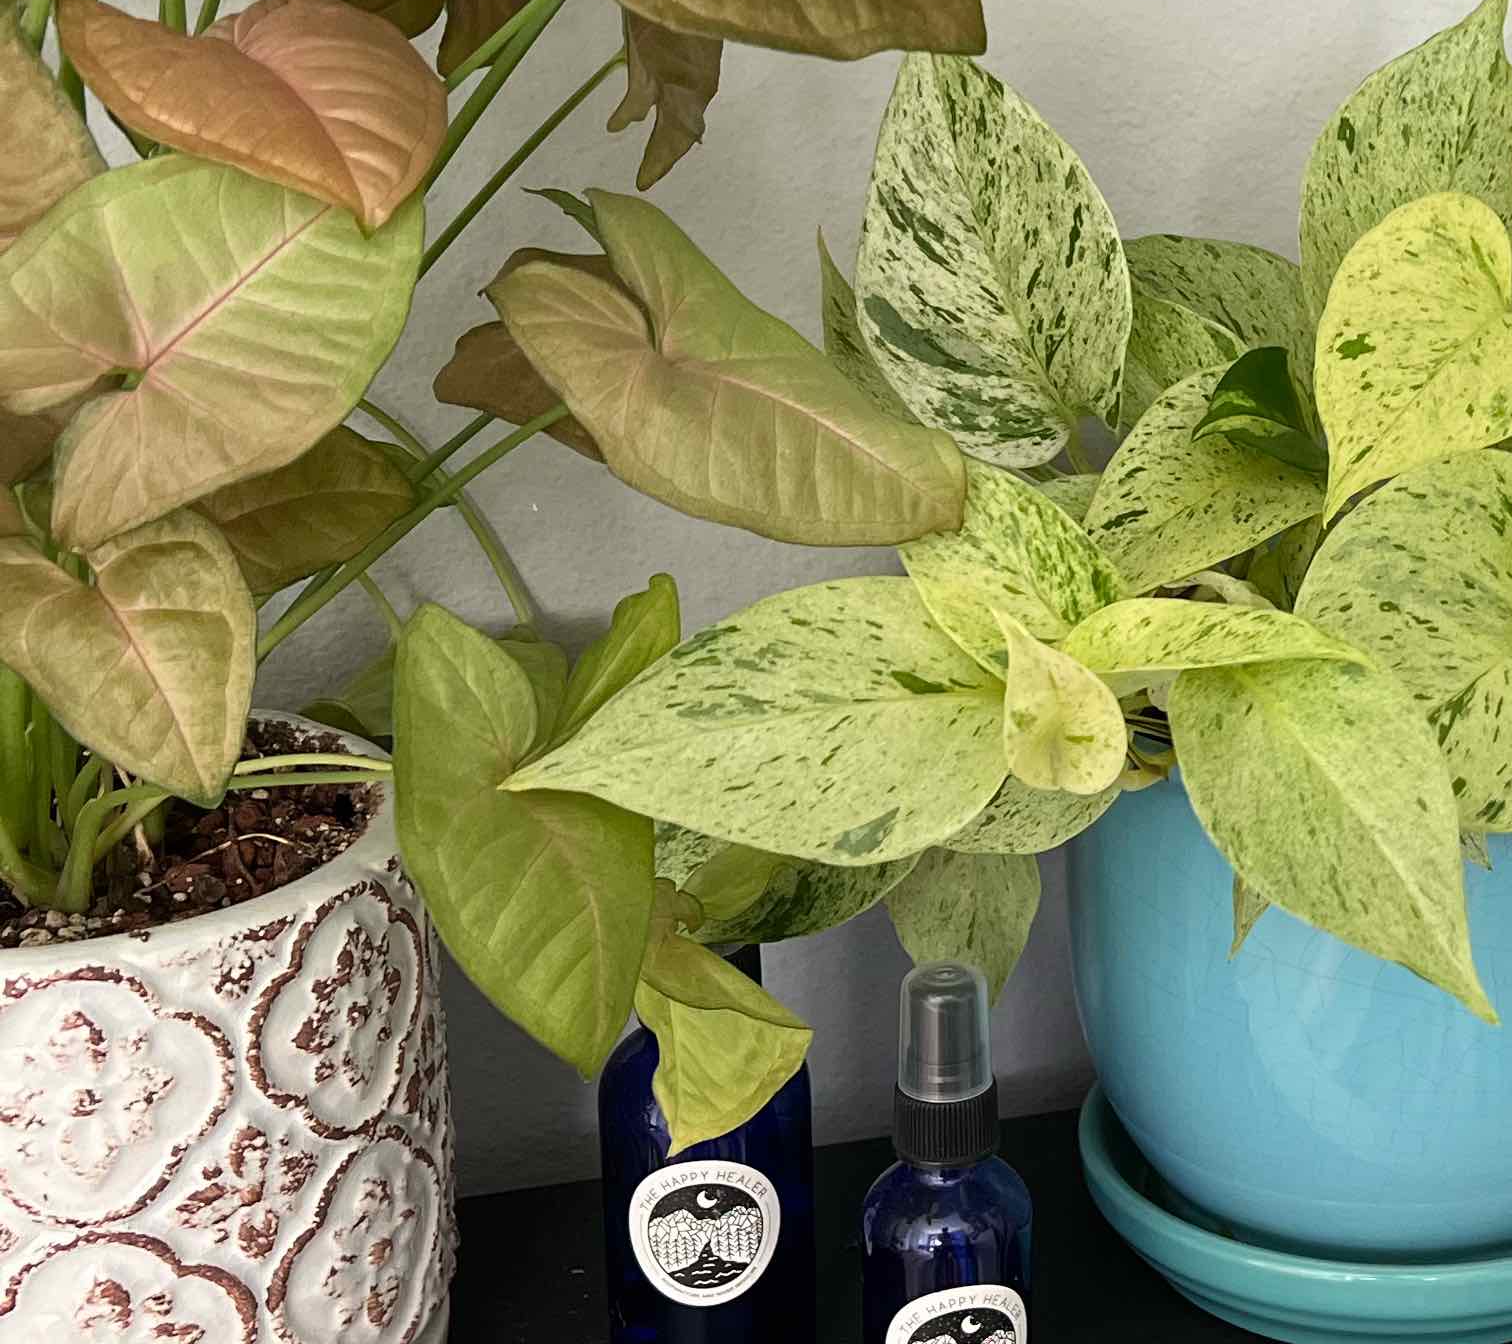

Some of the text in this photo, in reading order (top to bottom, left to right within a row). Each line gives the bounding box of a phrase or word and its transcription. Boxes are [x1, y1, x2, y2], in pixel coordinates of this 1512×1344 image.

[640, 1171, 768, 1210] THE HAPPY HEALER
[899, 1294, 1023, 1334] THE HAPPY HEALER
